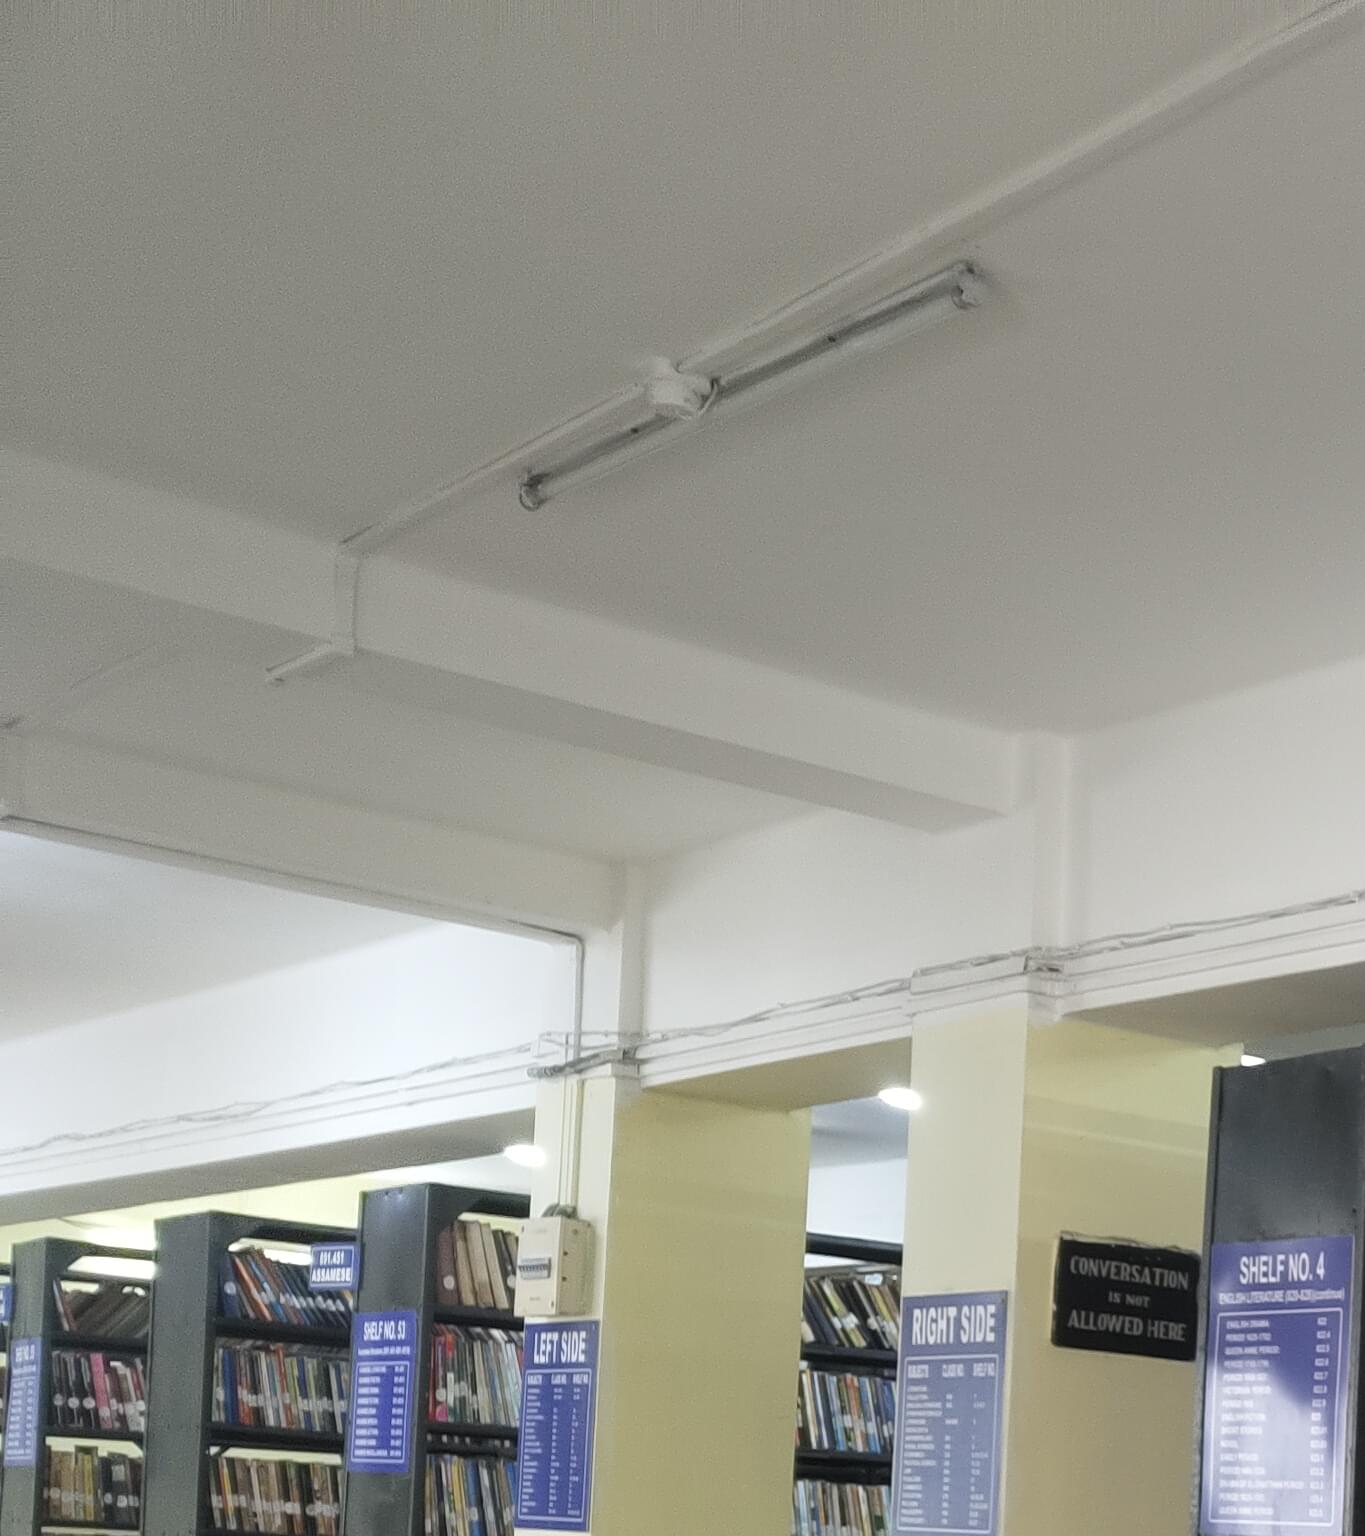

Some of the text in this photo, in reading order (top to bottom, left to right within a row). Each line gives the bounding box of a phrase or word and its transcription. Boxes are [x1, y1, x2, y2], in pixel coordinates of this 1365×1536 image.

[311, 1267, 351, 1282] ASSAMESE
[1070, 1255, 1189, 1290] CONVERSATION
[1239, 1251, 1325, 1284] SHELF NO. 4
[1108, 1290, 1150, 1308] IS NOT
[363, 1320, 383, 1341] SHELF
[911, 1304, 996, 1345] RIGHT SIDE
[1067, 1309, 1187, 1342] ALLOWED HERE
[533, 1330, 586, 1364] LEFT SIDE
